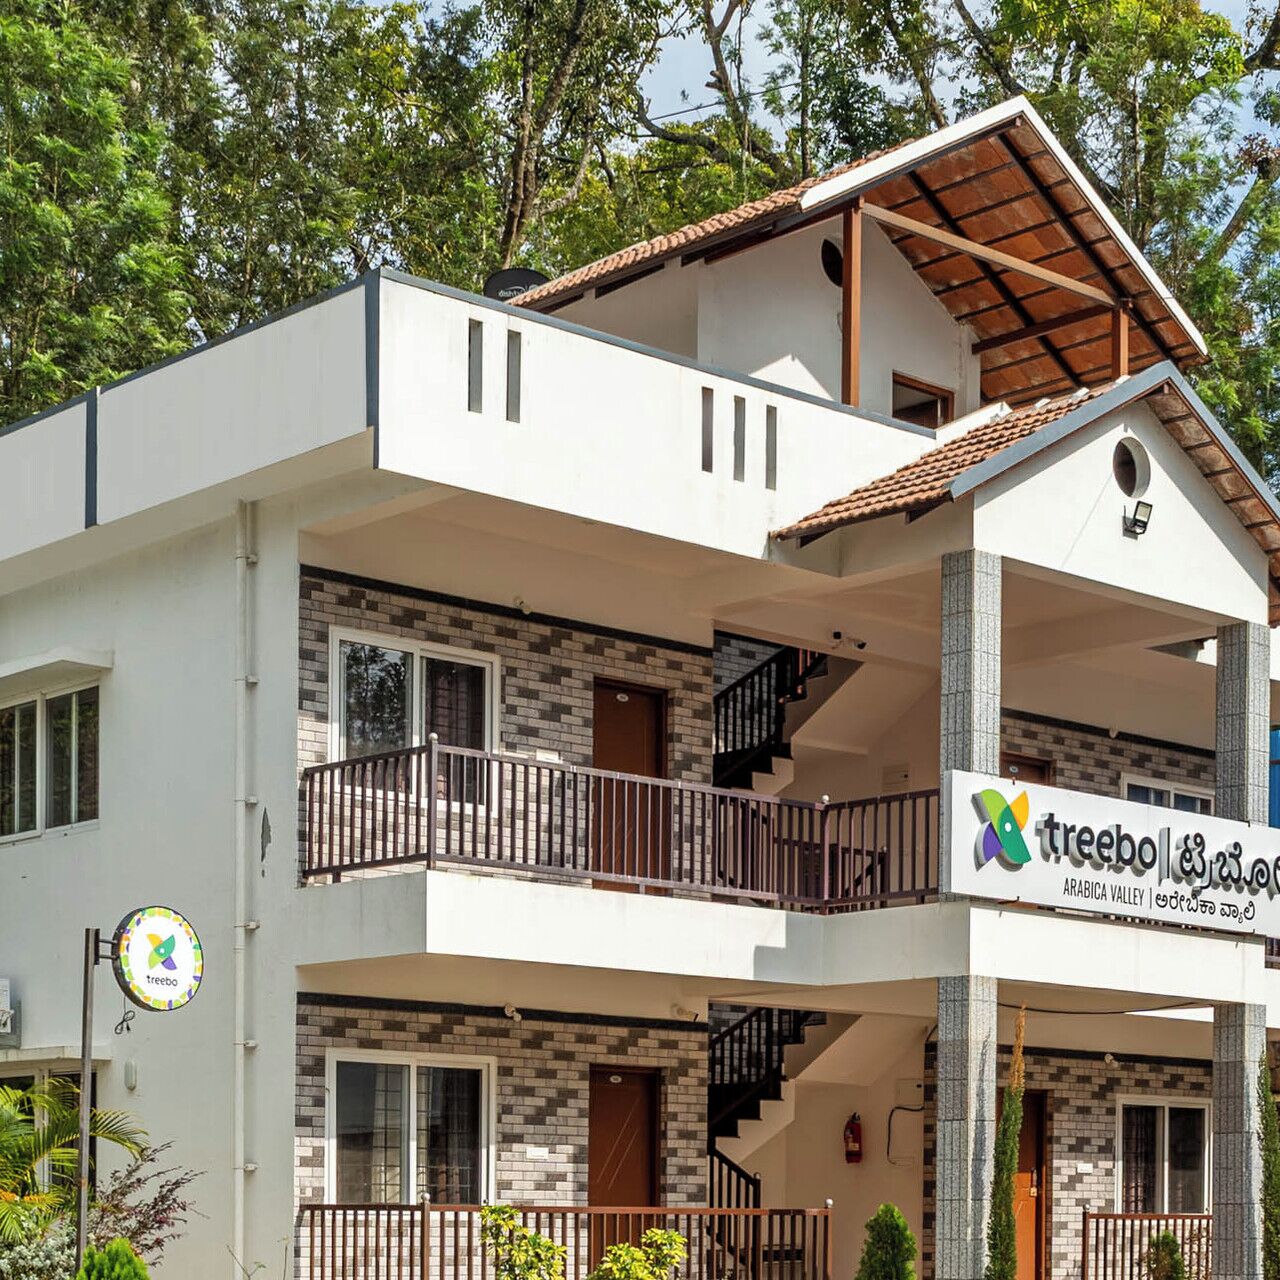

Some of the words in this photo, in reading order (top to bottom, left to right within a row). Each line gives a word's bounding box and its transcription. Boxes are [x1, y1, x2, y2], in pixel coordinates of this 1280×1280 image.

[1039, 812, 1157, 870] treebo
[1063, 877, 1108, 901] ARABICA
[1110, 884, 1145, 907] VALLEY
[146, 975, 178, 987] treebo
